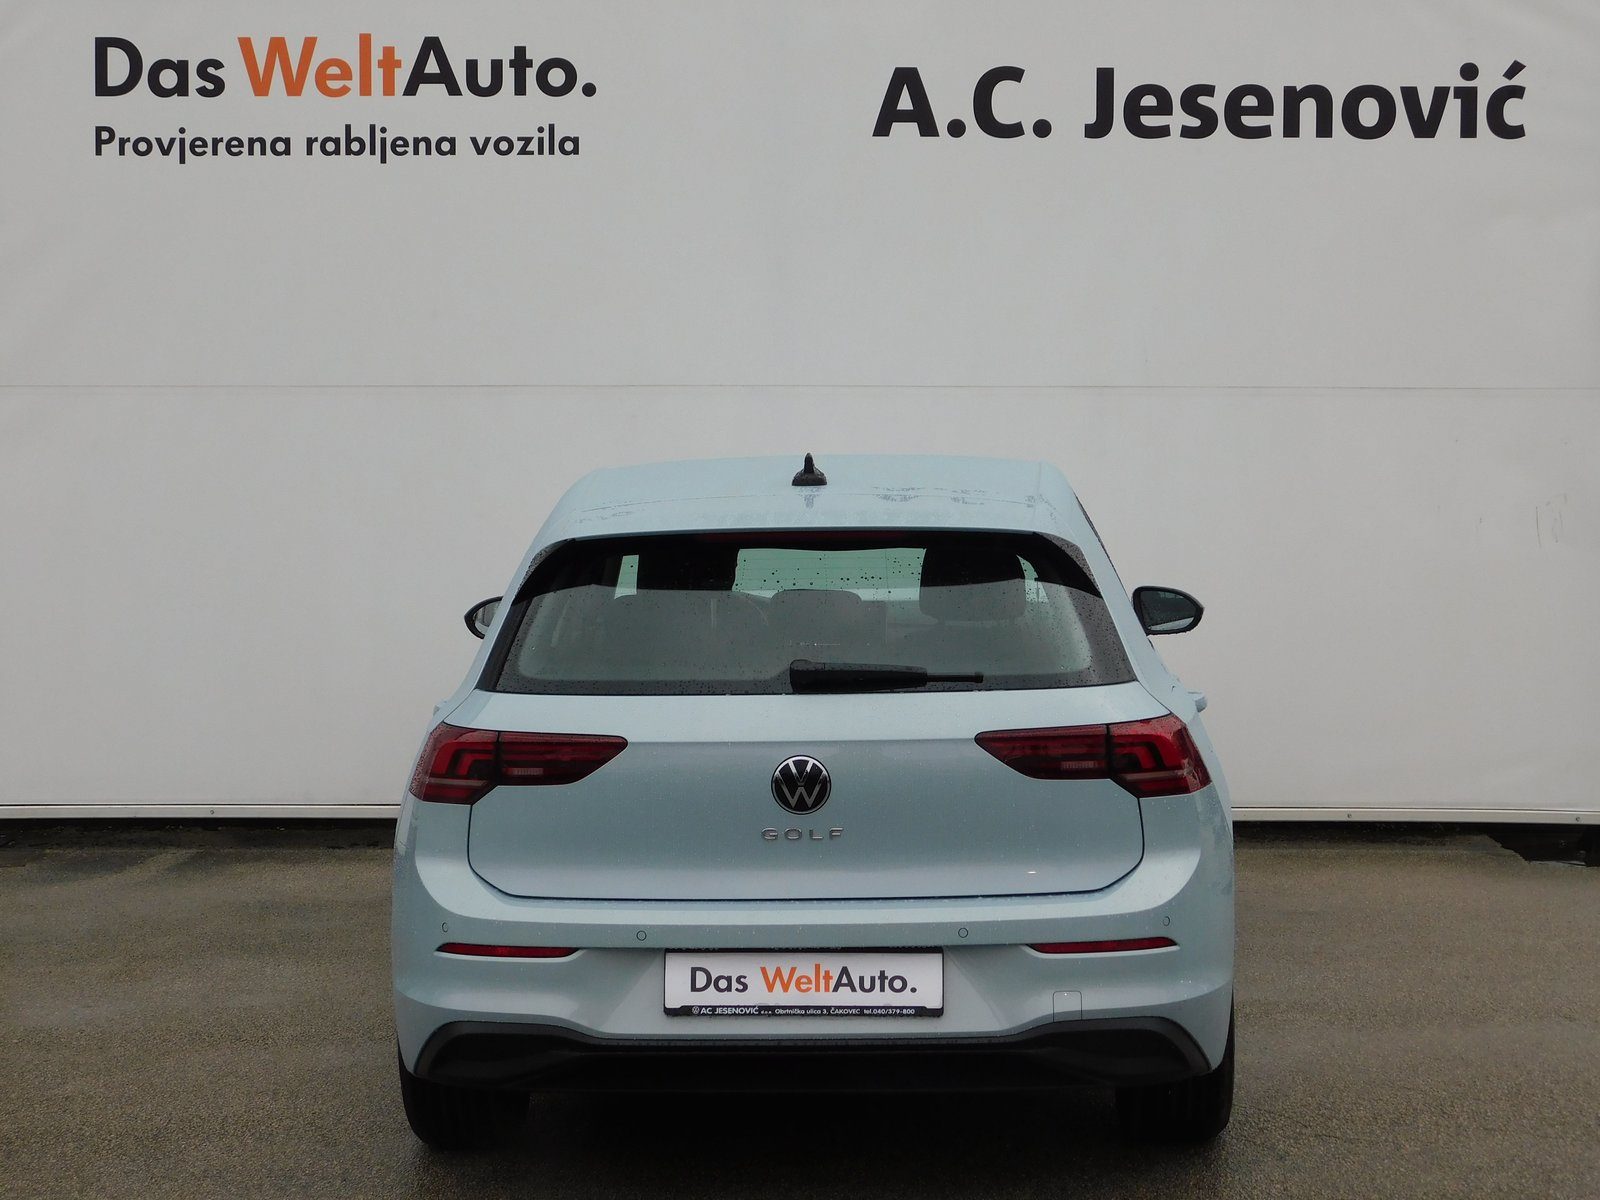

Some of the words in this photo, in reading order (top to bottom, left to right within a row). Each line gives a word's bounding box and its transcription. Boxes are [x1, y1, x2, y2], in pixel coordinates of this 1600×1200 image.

[94, 37, 225, 98] Das
[237, 33, 598, 98] WeltAuto.
[872, 65, 1052, 139] A.C.
[1084, 59, 1527, 140] Jesenović
[94, 126, 292, 164] Provjerena
[305, 124, 457, 164] rabljena
[469, 124, 581, 157] vozila
[762, 827, 844, 840] GOLF
[690, 967, 748, 993] Das
[760, 963, 917, 993] WeltAuto.
[714, 1006, 758, 1014] JESENOVIĆ
